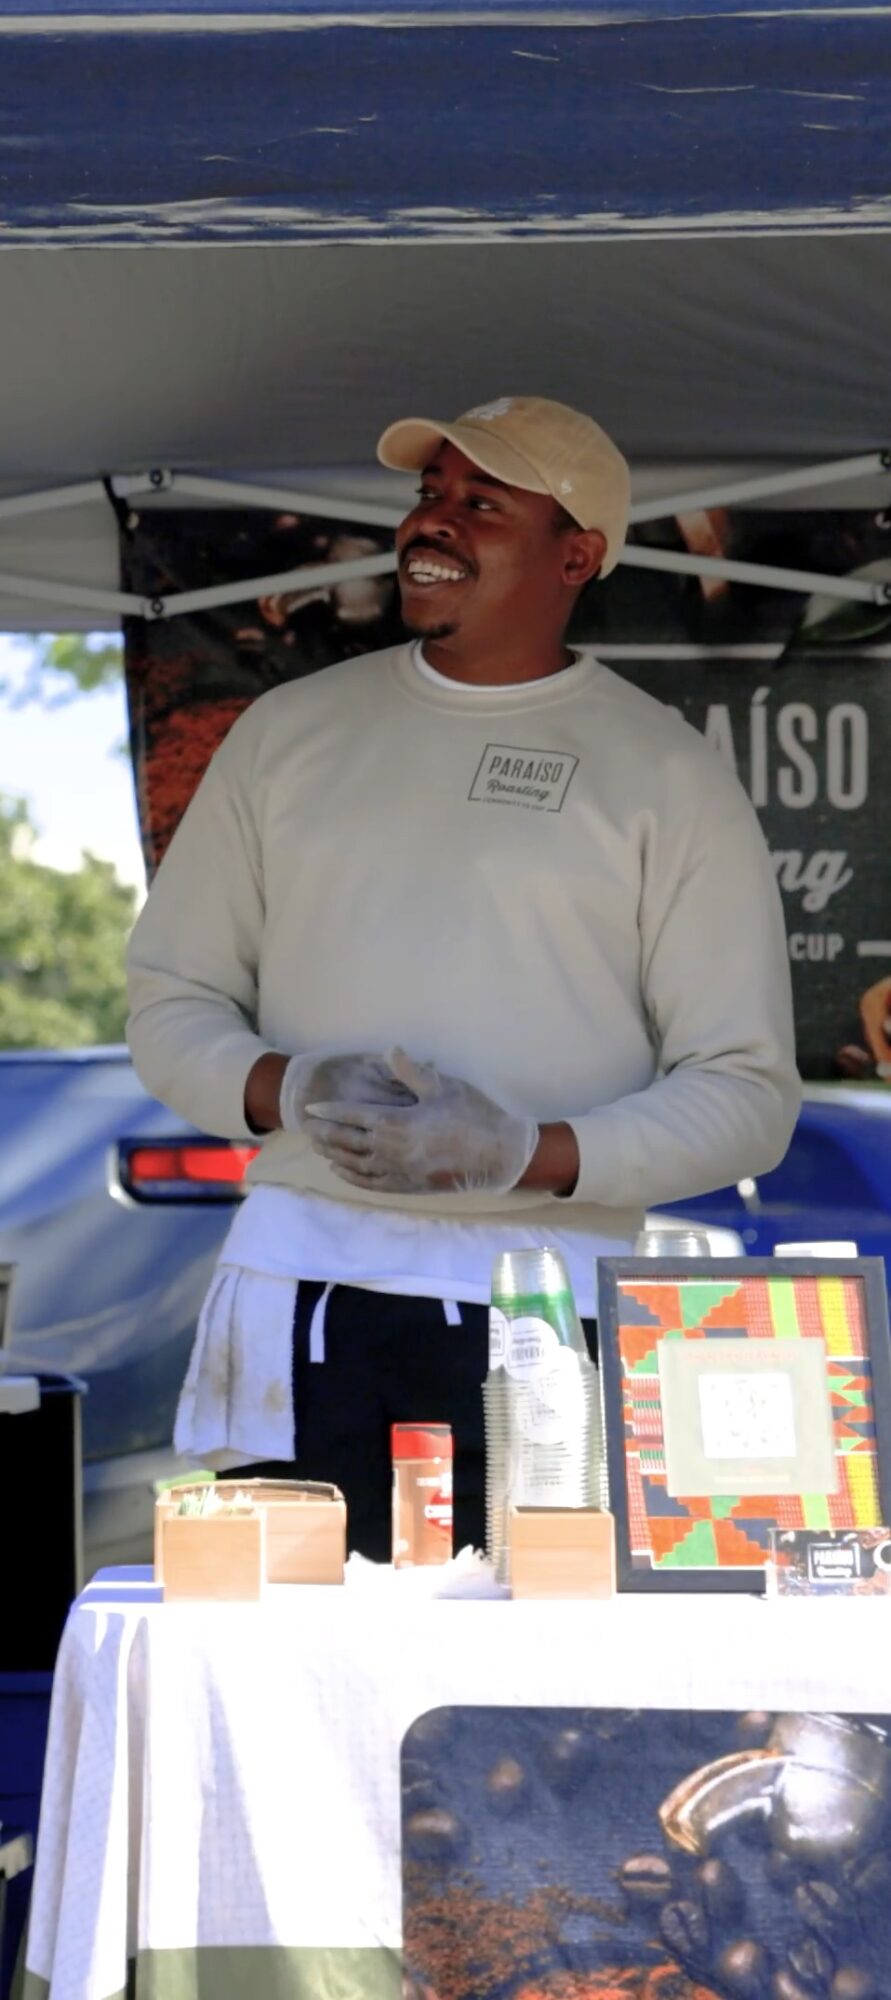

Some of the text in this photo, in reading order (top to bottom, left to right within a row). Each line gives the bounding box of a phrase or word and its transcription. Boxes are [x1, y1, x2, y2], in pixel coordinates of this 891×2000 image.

[703, 685, 868, 810] AÍSO
[486, 778, 551, 802] Roasting
[788, 932, 844, 961] CUP
